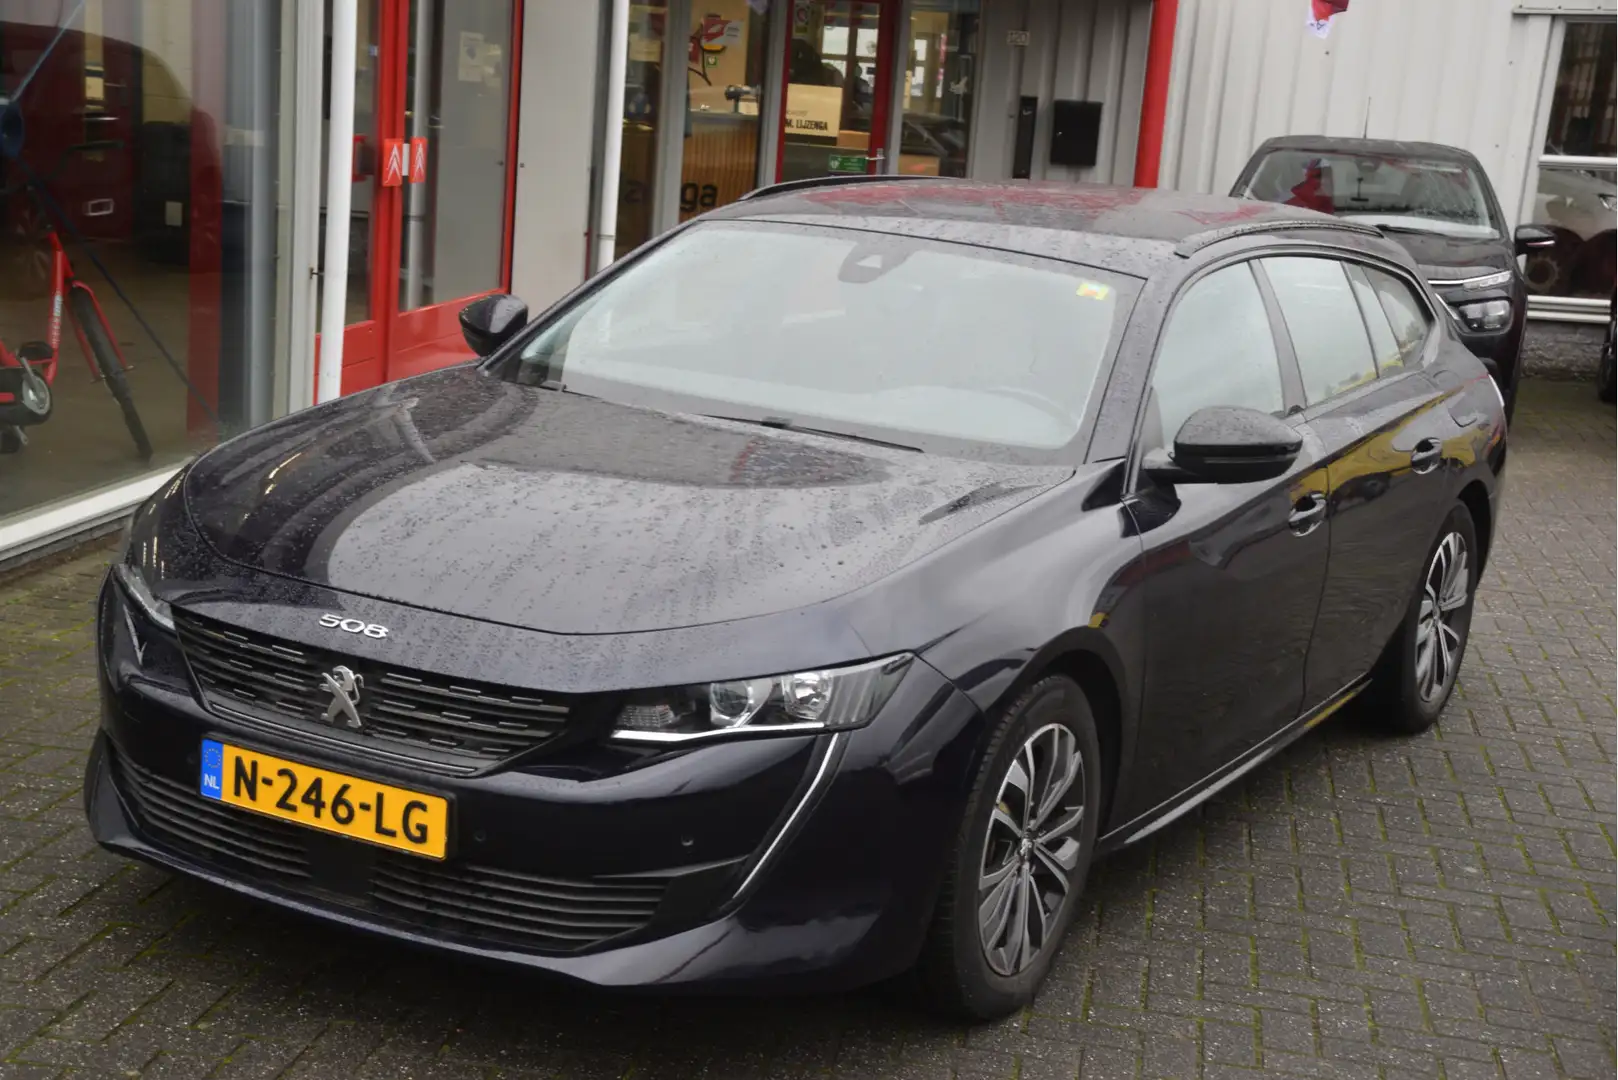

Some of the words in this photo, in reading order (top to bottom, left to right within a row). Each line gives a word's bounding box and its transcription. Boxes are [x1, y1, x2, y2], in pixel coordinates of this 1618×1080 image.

[319, 613, 389, 639] 508
[203, 773, 220, 790] NL
[233, 755, 428, 844] N-246-LG
